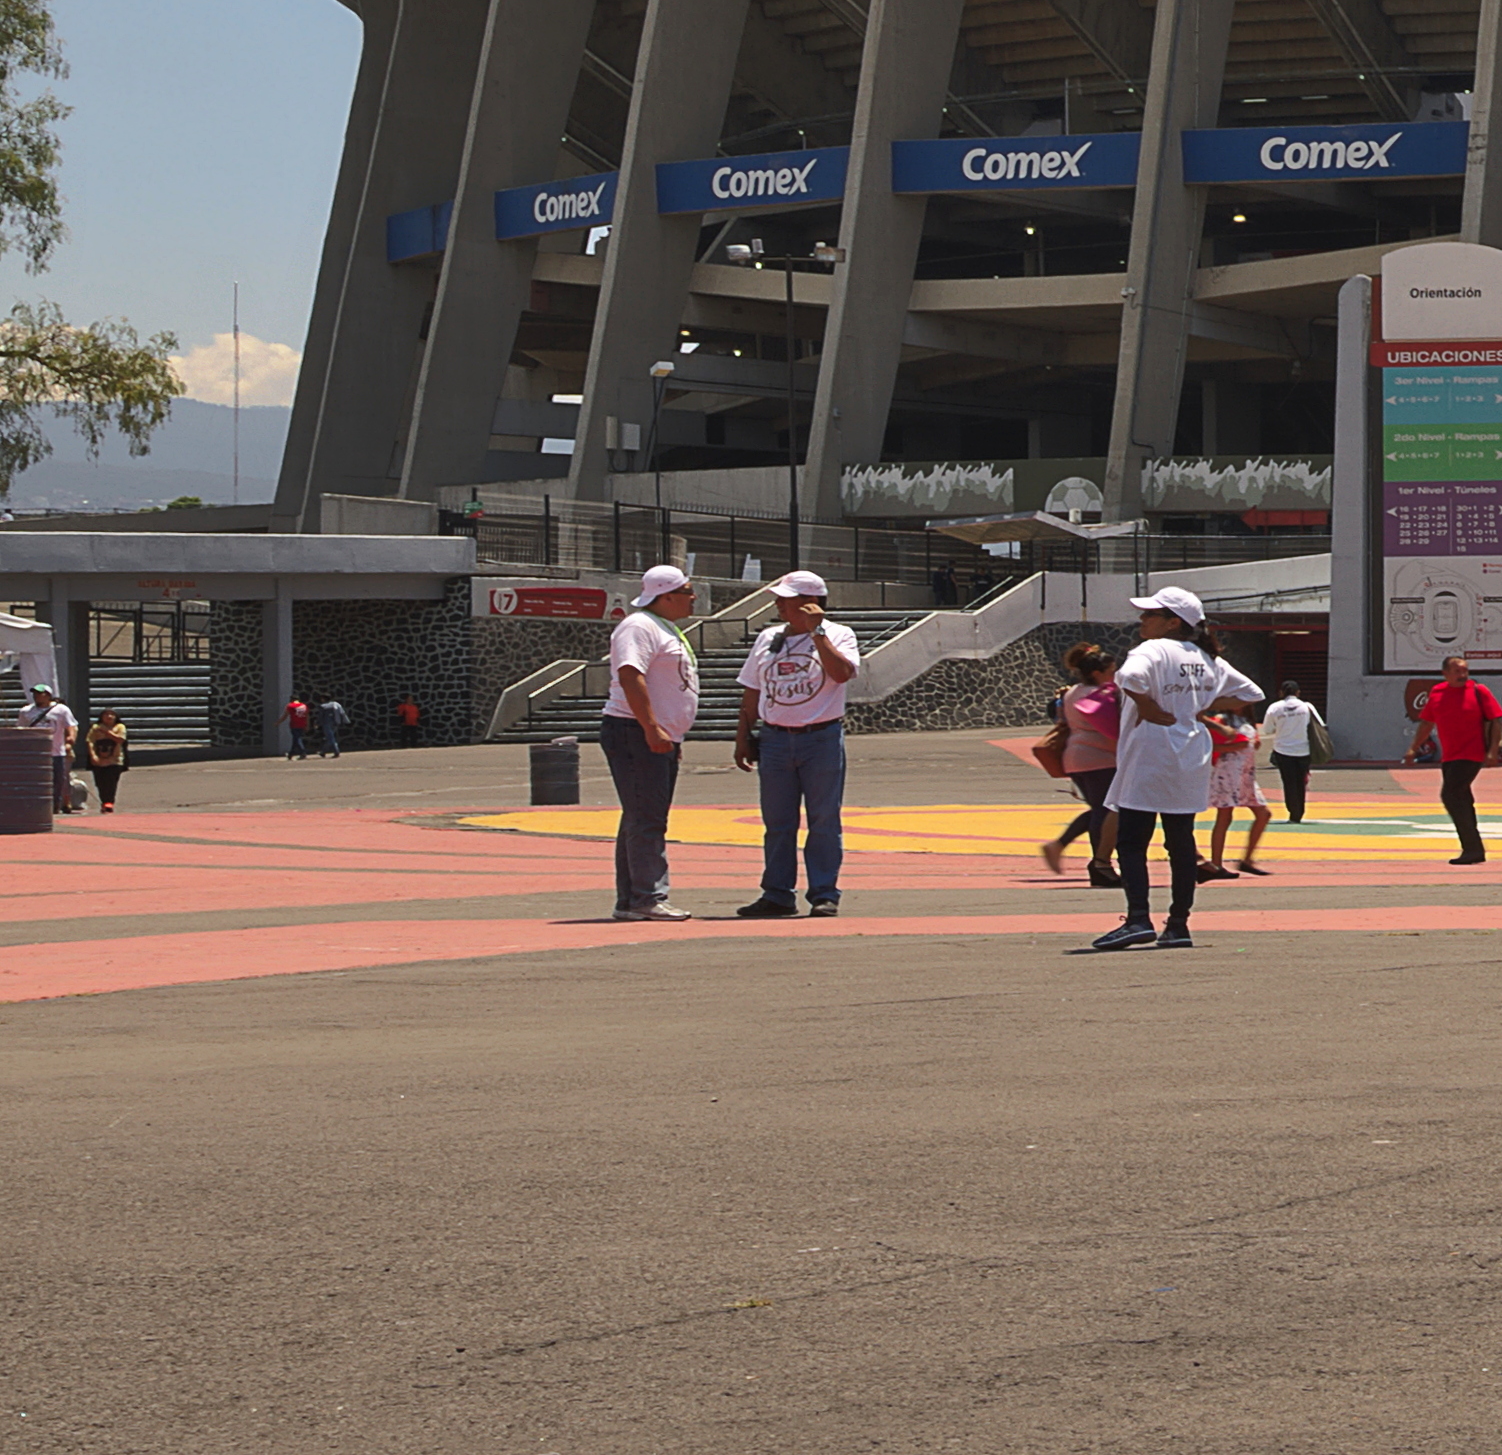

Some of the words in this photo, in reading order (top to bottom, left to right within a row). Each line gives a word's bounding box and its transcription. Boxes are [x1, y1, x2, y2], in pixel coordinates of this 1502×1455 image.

[962, 141, 1092, 181] Comex
[1260, 132, 1402, 170] Comex
[712, 158, 817, 199] Comex
[534, 180, 606, 223] Comex
[1409, 286, 1482, 299] Orientación
